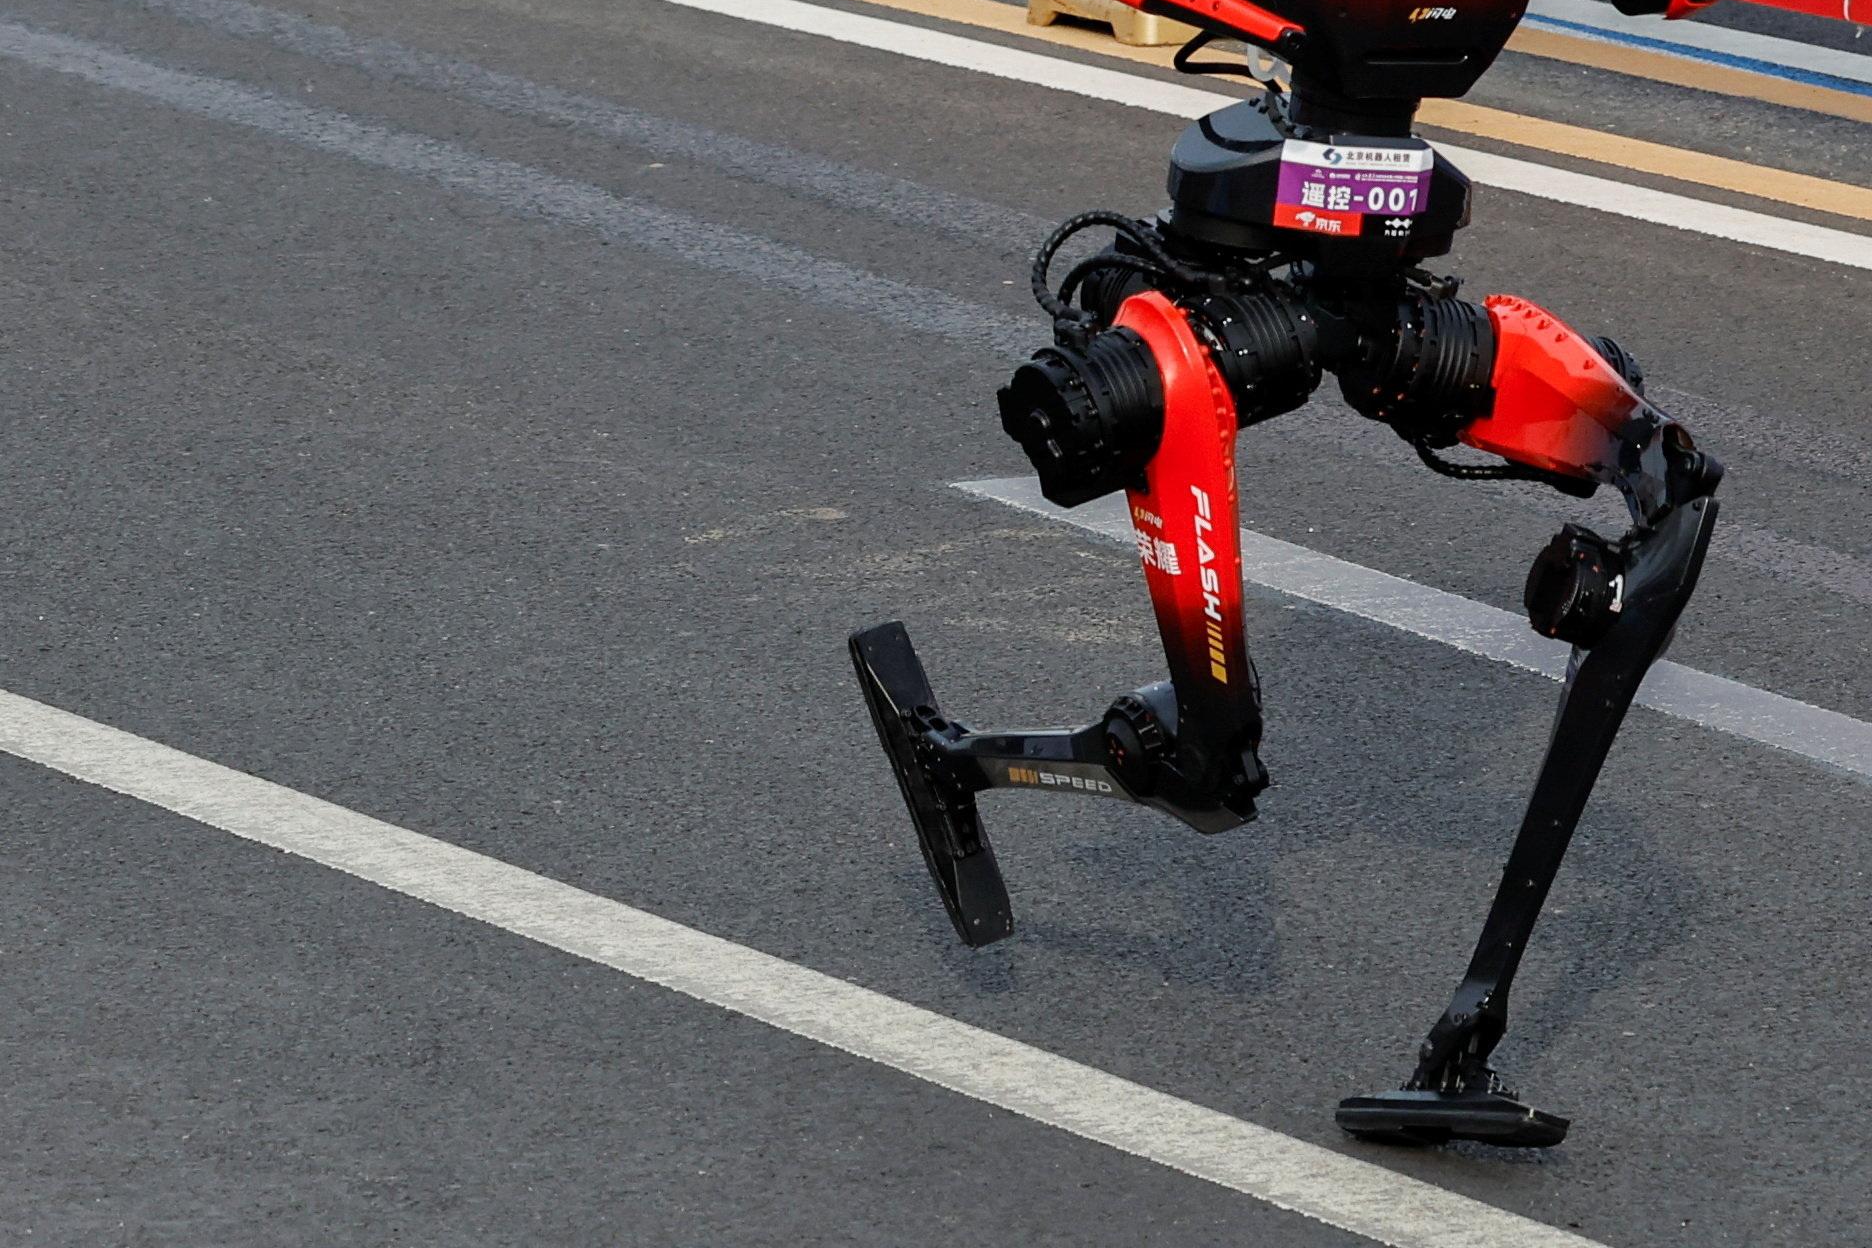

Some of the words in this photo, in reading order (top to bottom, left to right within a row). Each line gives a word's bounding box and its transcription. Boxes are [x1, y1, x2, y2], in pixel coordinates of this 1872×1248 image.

[1346, 150, 1411, 163] 北京机器人租赁
[1301, 181, 1419, 212] 遥控-001
[1315, 217, 1342, 233] 京东
[1190, 484, 1222, 622] FLASH
[1039, 772, 1112, 793] SPEED
